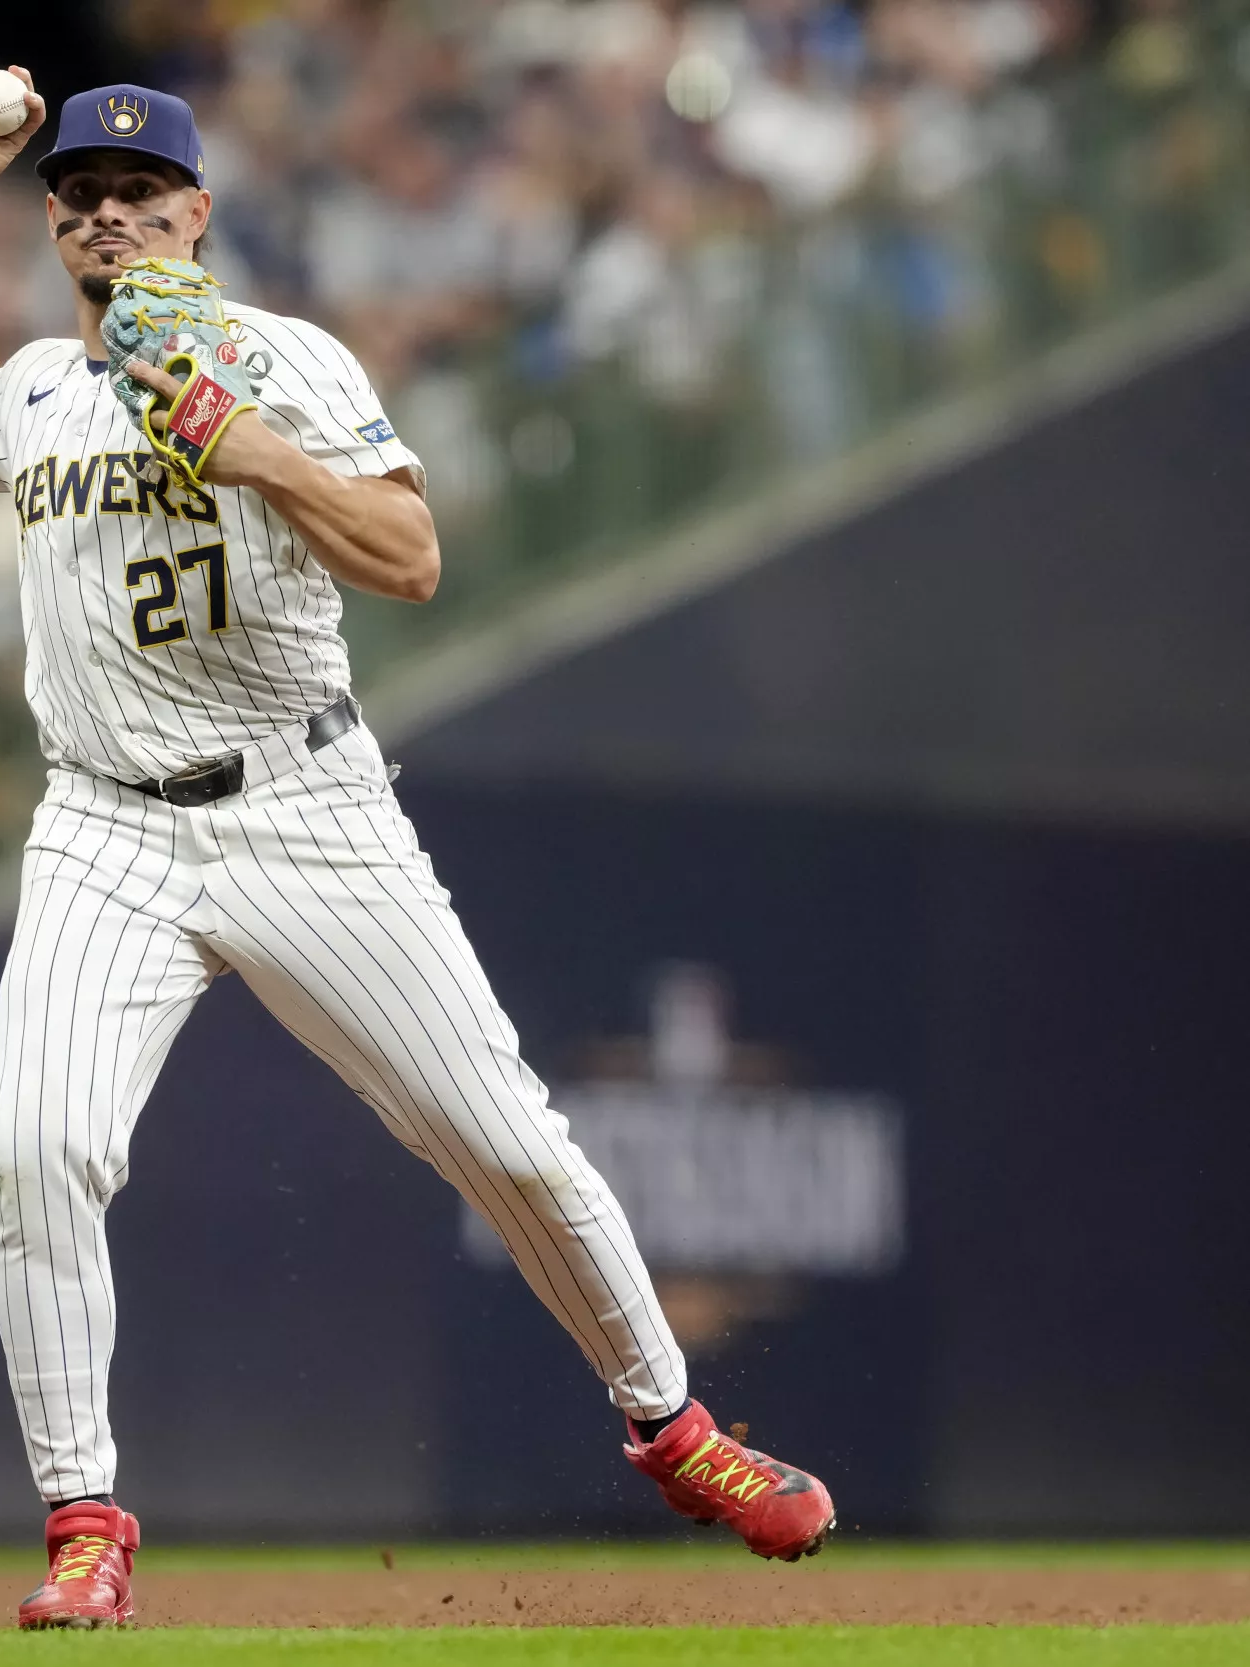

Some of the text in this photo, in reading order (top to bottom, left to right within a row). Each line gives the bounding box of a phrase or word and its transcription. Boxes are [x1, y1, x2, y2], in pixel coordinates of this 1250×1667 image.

[184, 385, 216, 436] Rawlings
[14, 450, 220, 531] REWERS
[124, 541, 230, 651] 27
